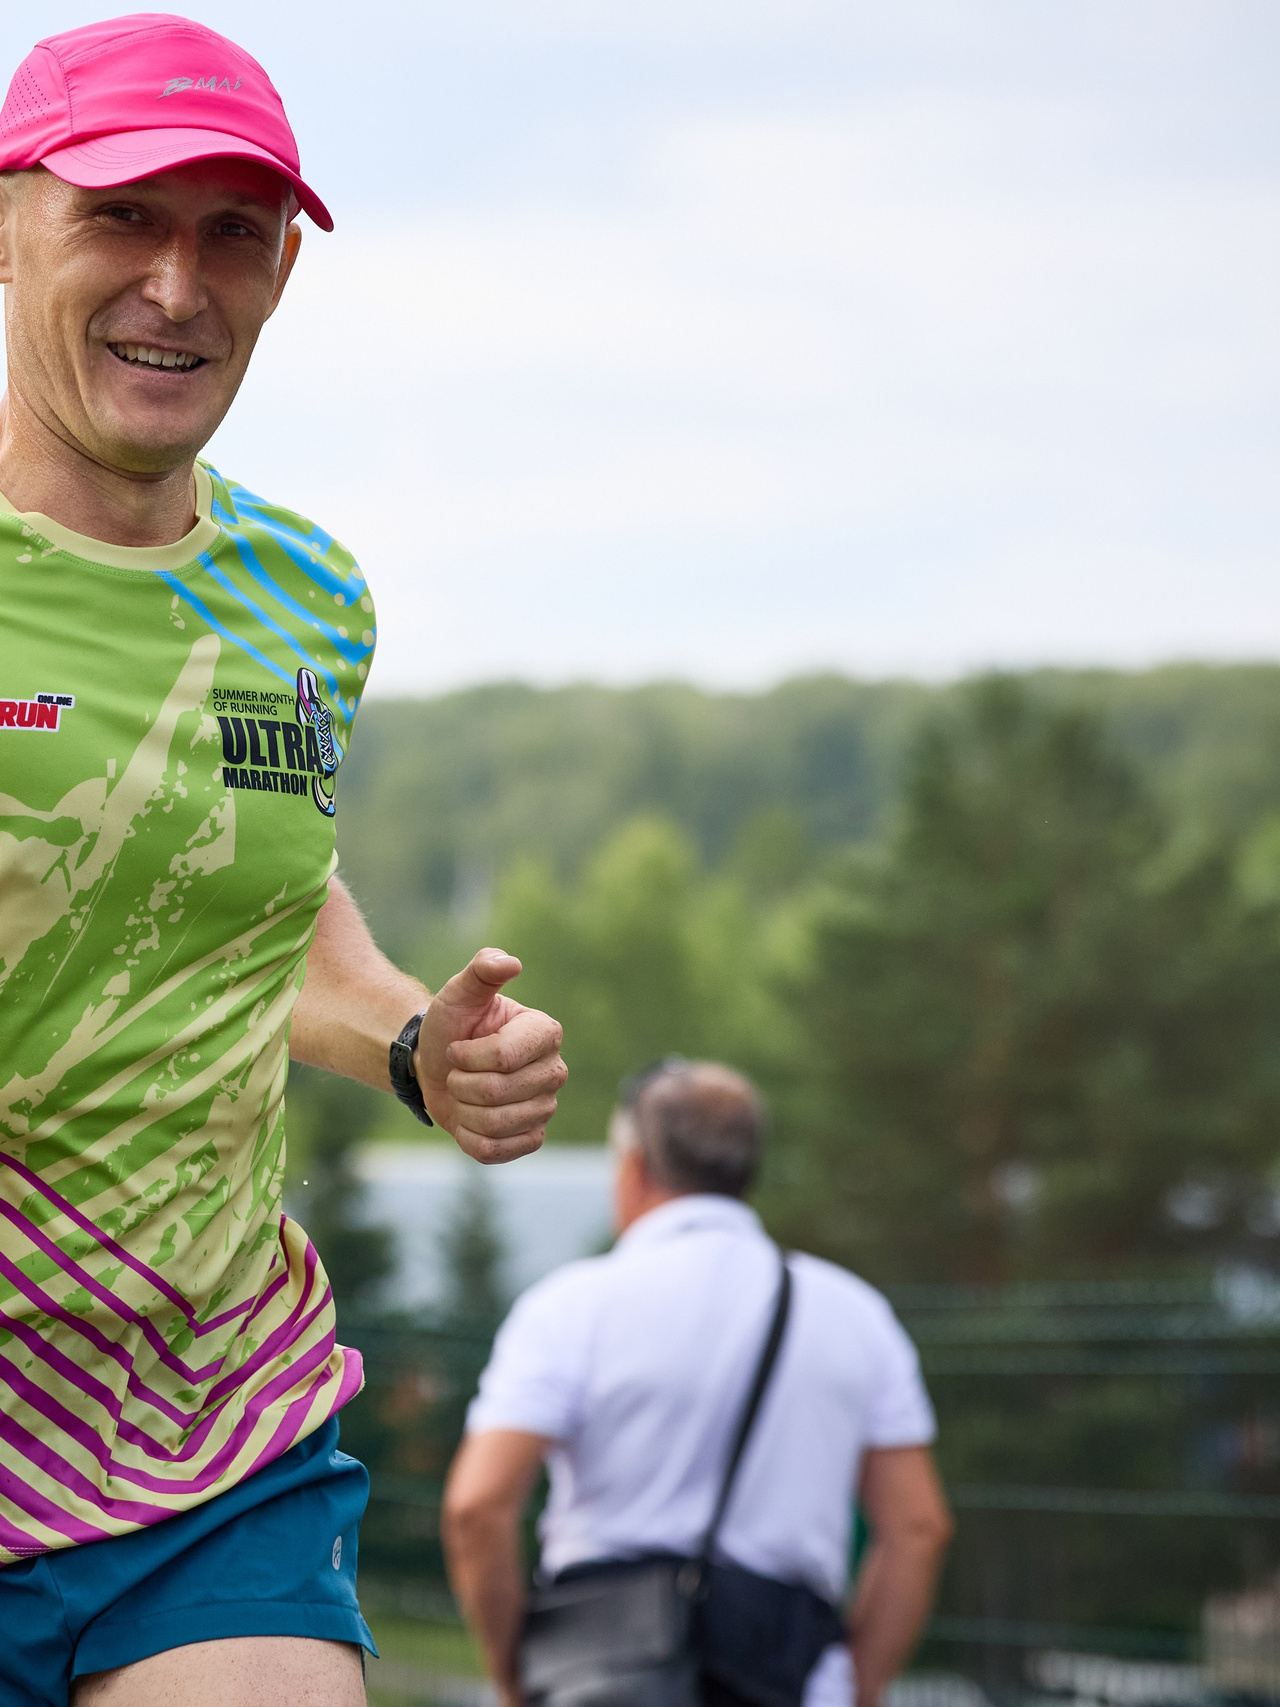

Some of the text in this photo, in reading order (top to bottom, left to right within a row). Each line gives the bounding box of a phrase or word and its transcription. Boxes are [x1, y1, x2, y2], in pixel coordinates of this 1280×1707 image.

[37, 694, 73, 706] ONLINE
[212, 688, 295, 705] SUMMER MONTH
[213, 701, 278, 716] OF RUNNING
[216, 716, 324, 774] ULTRA
[222, 766, 308, 797] MARATHON
